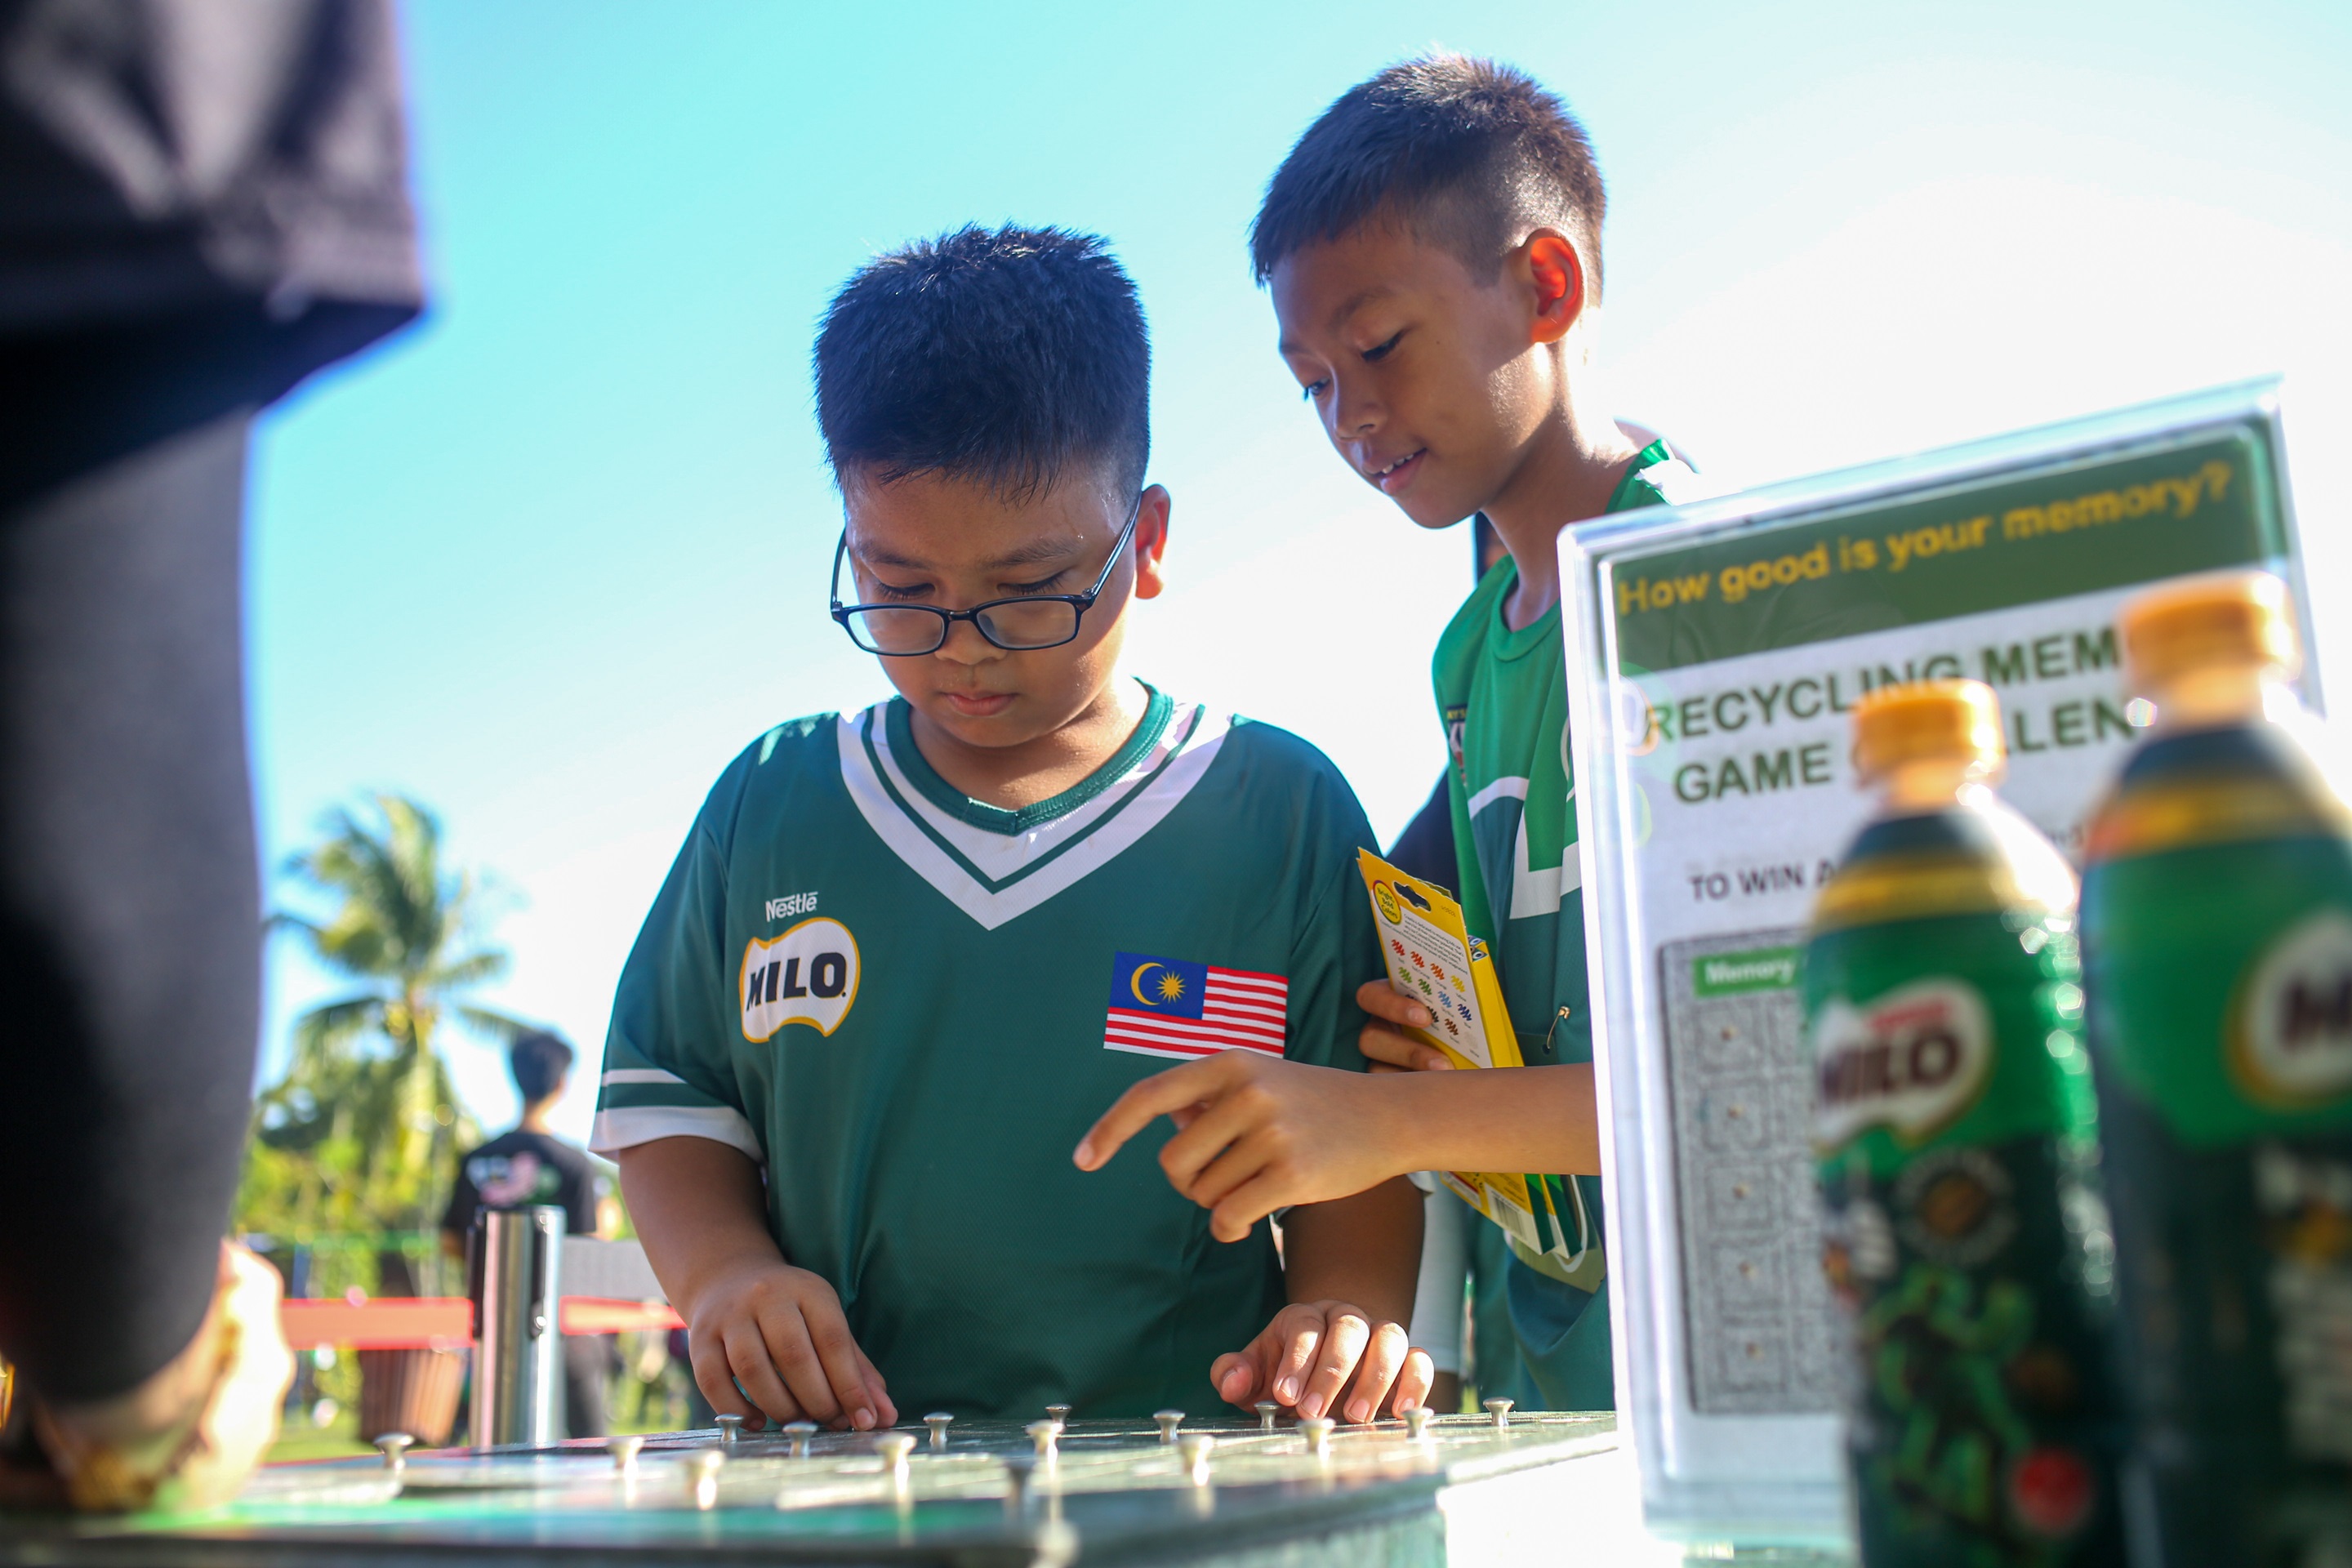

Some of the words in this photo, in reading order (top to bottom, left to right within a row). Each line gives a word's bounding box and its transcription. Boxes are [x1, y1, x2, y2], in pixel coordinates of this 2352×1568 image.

[1617, 570, 1710, 616] How
[1719, 541, 1830, 604] good
[1838, 536, 1878, 572] is
[1886, 515, 1992, 572] your
[2002, 460, 2233, 541] memory?
[1980, 624, 2123, 686] MEM
[1674, 742, 1832, 804] GAME
[1687, 871, 1730, 902] TO
[1737, 862, 1804, 897] WIN
